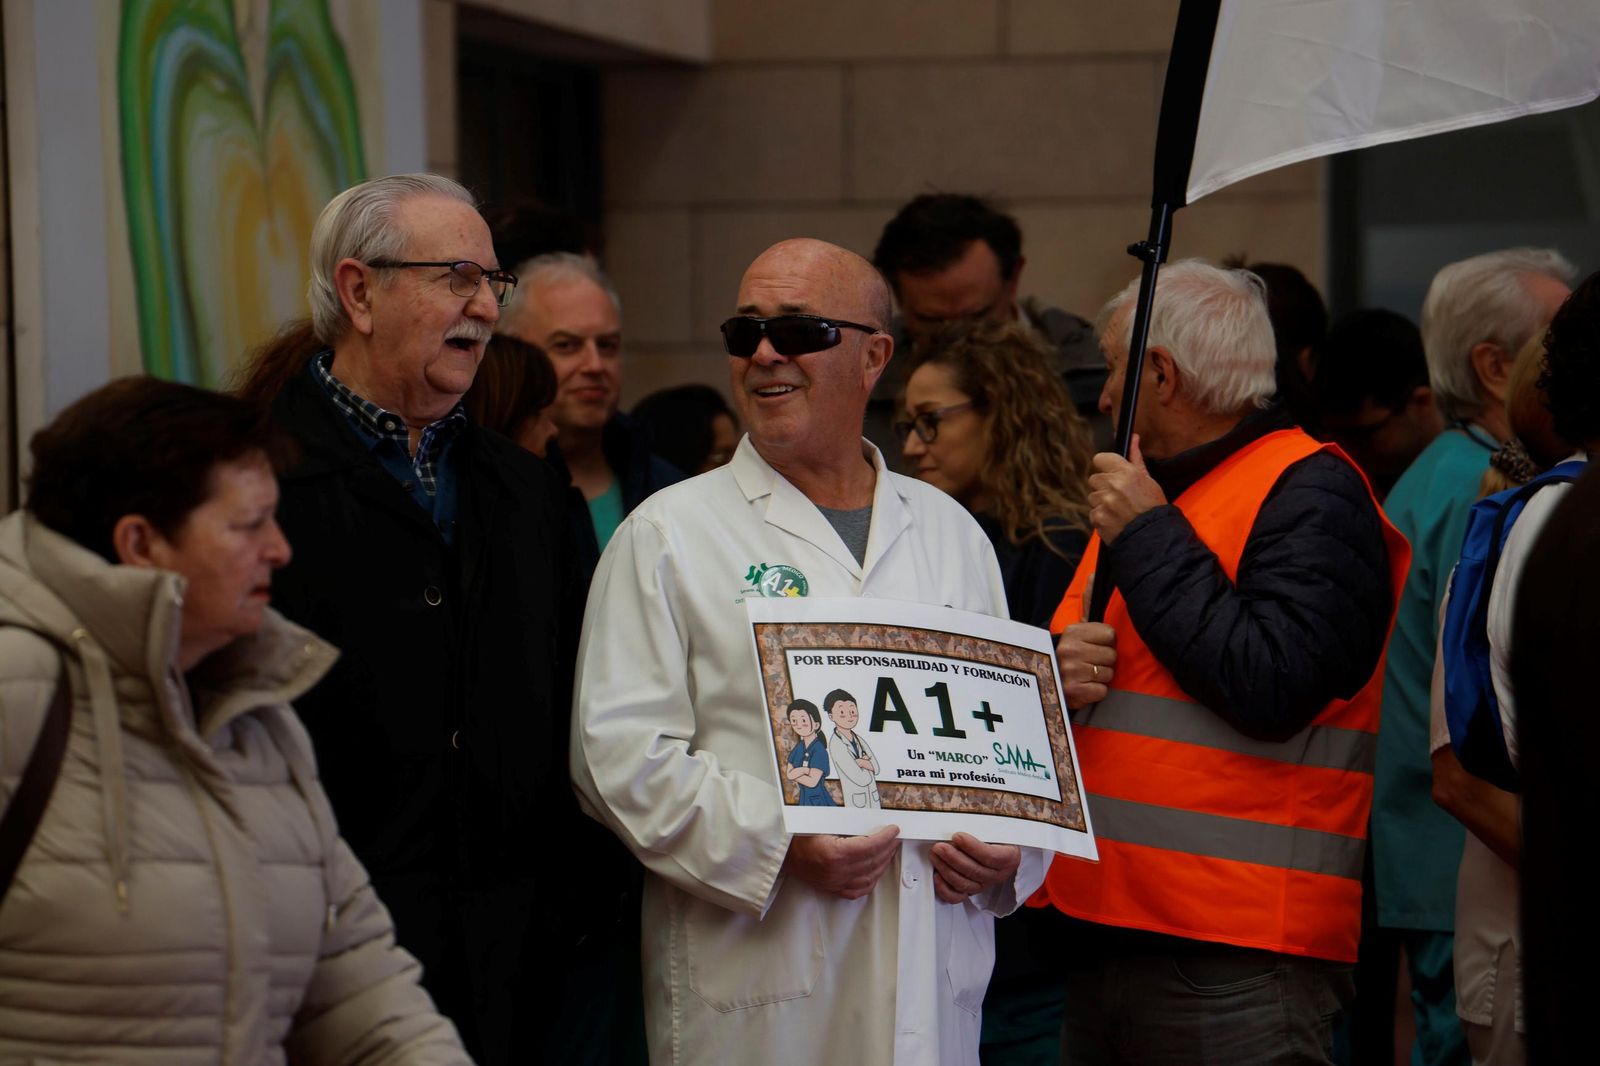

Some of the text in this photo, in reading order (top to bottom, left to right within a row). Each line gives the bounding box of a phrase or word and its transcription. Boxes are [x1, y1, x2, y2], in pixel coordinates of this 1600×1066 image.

[793, 655, 1031, 688] POR RESPONSABILIDAD Y FORMACIÓN
[869, 676, 1004, 739] A1+
[907, 749, 925, 761] Un
[993, 742, 1046, 772] SMA
[896, 768, 927, 781] para
[929, 768, 945, 780] mi
[949, 769, 1006, 785] profesión
